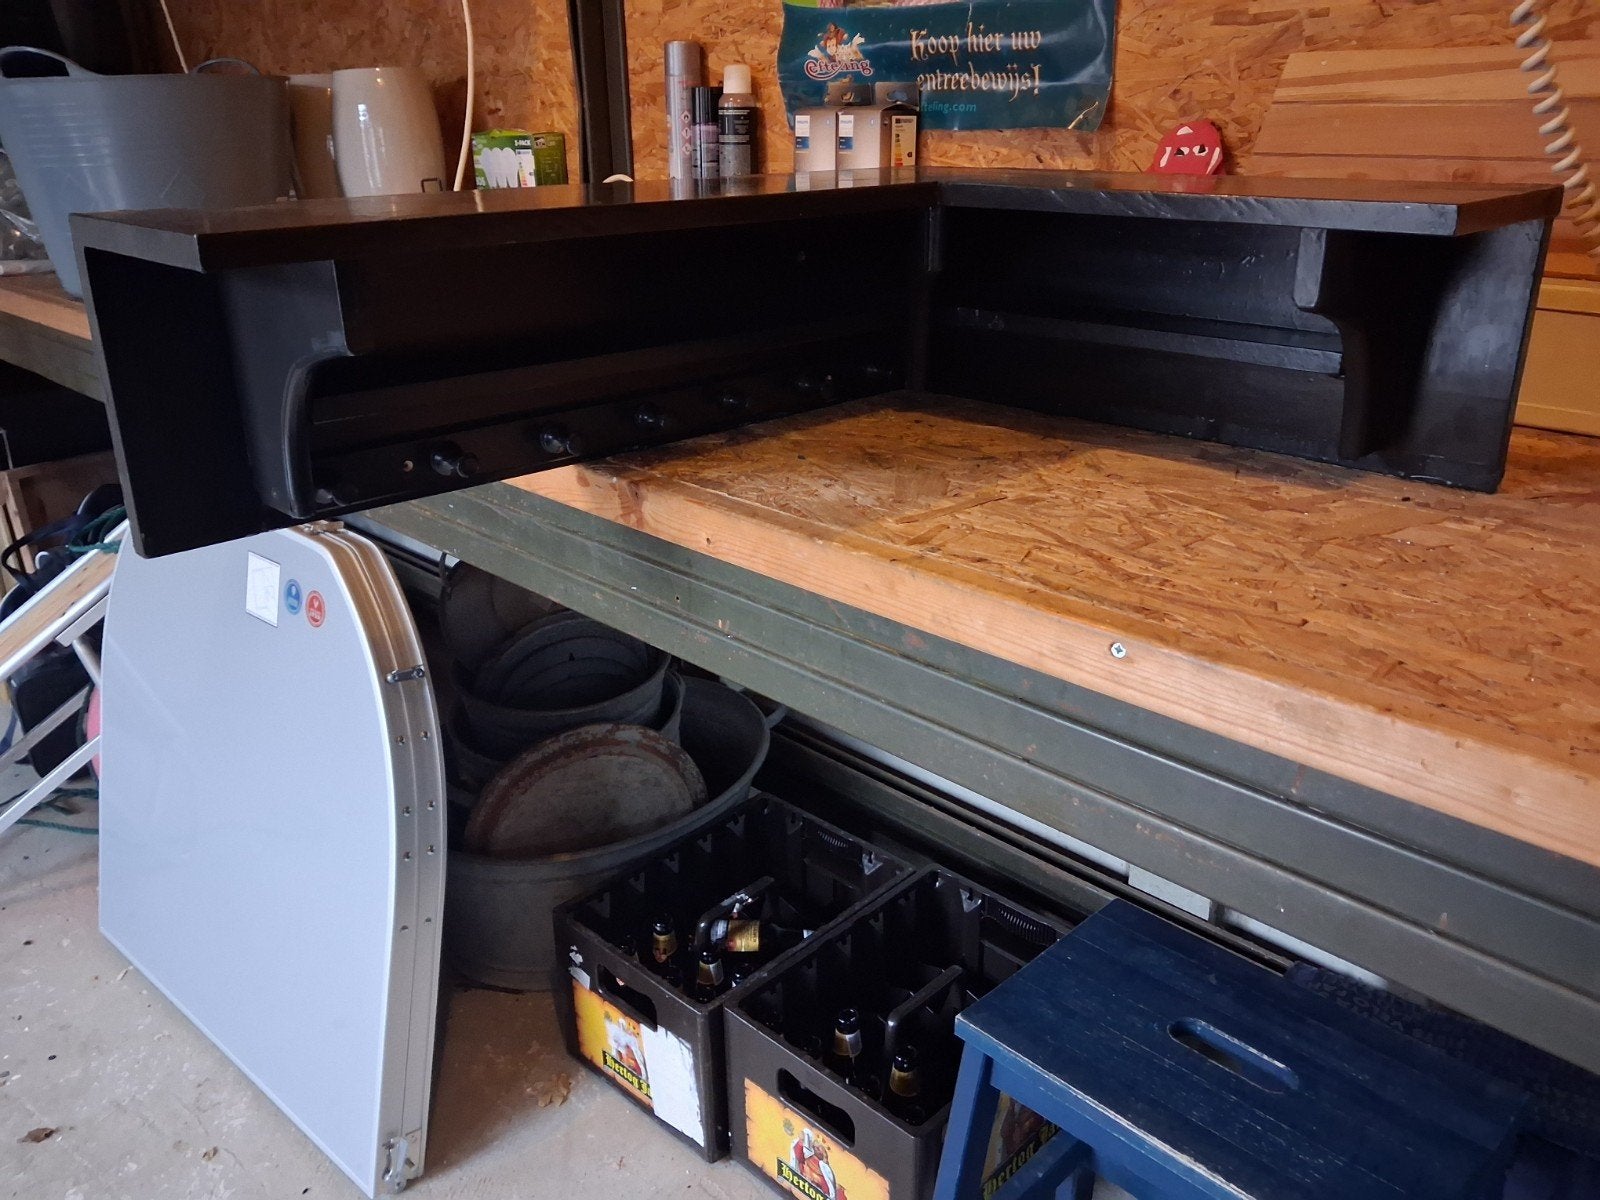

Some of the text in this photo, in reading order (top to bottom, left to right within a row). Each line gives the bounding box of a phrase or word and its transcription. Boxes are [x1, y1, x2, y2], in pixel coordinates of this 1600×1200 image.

[909, 21, 1042, 66] Koop hier uw
[916, 61, 1042, 102] entreebewijs!
[605, 1052, 639, 1088] Hertog
